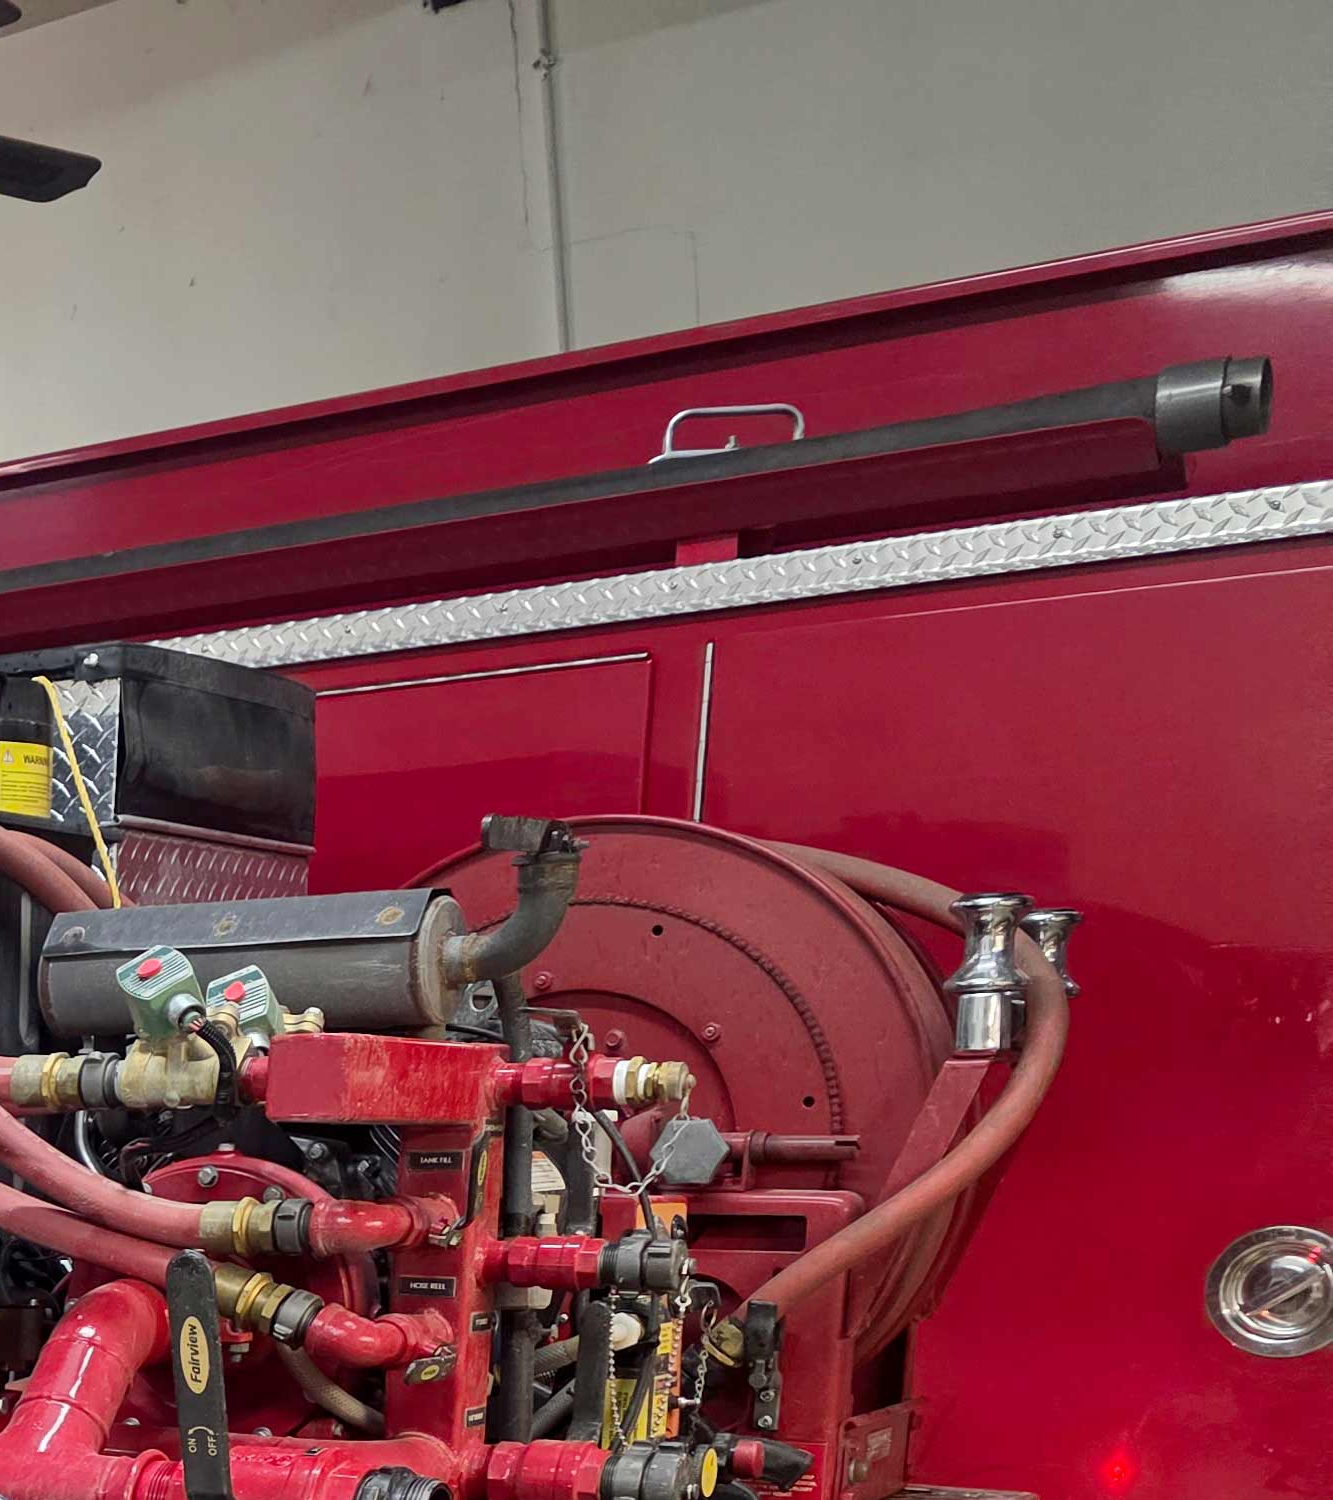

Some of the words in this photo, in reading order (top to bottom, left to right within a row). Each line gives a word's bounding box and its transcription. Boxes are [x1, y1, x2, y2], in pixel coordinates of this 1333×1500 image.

[23, 754, 48, 766] WARN
[188, 1323, 202, 1383] Fairview
[188, 1438, 197, 1453] ON
[207, 1435, 217, 1456] OFF
